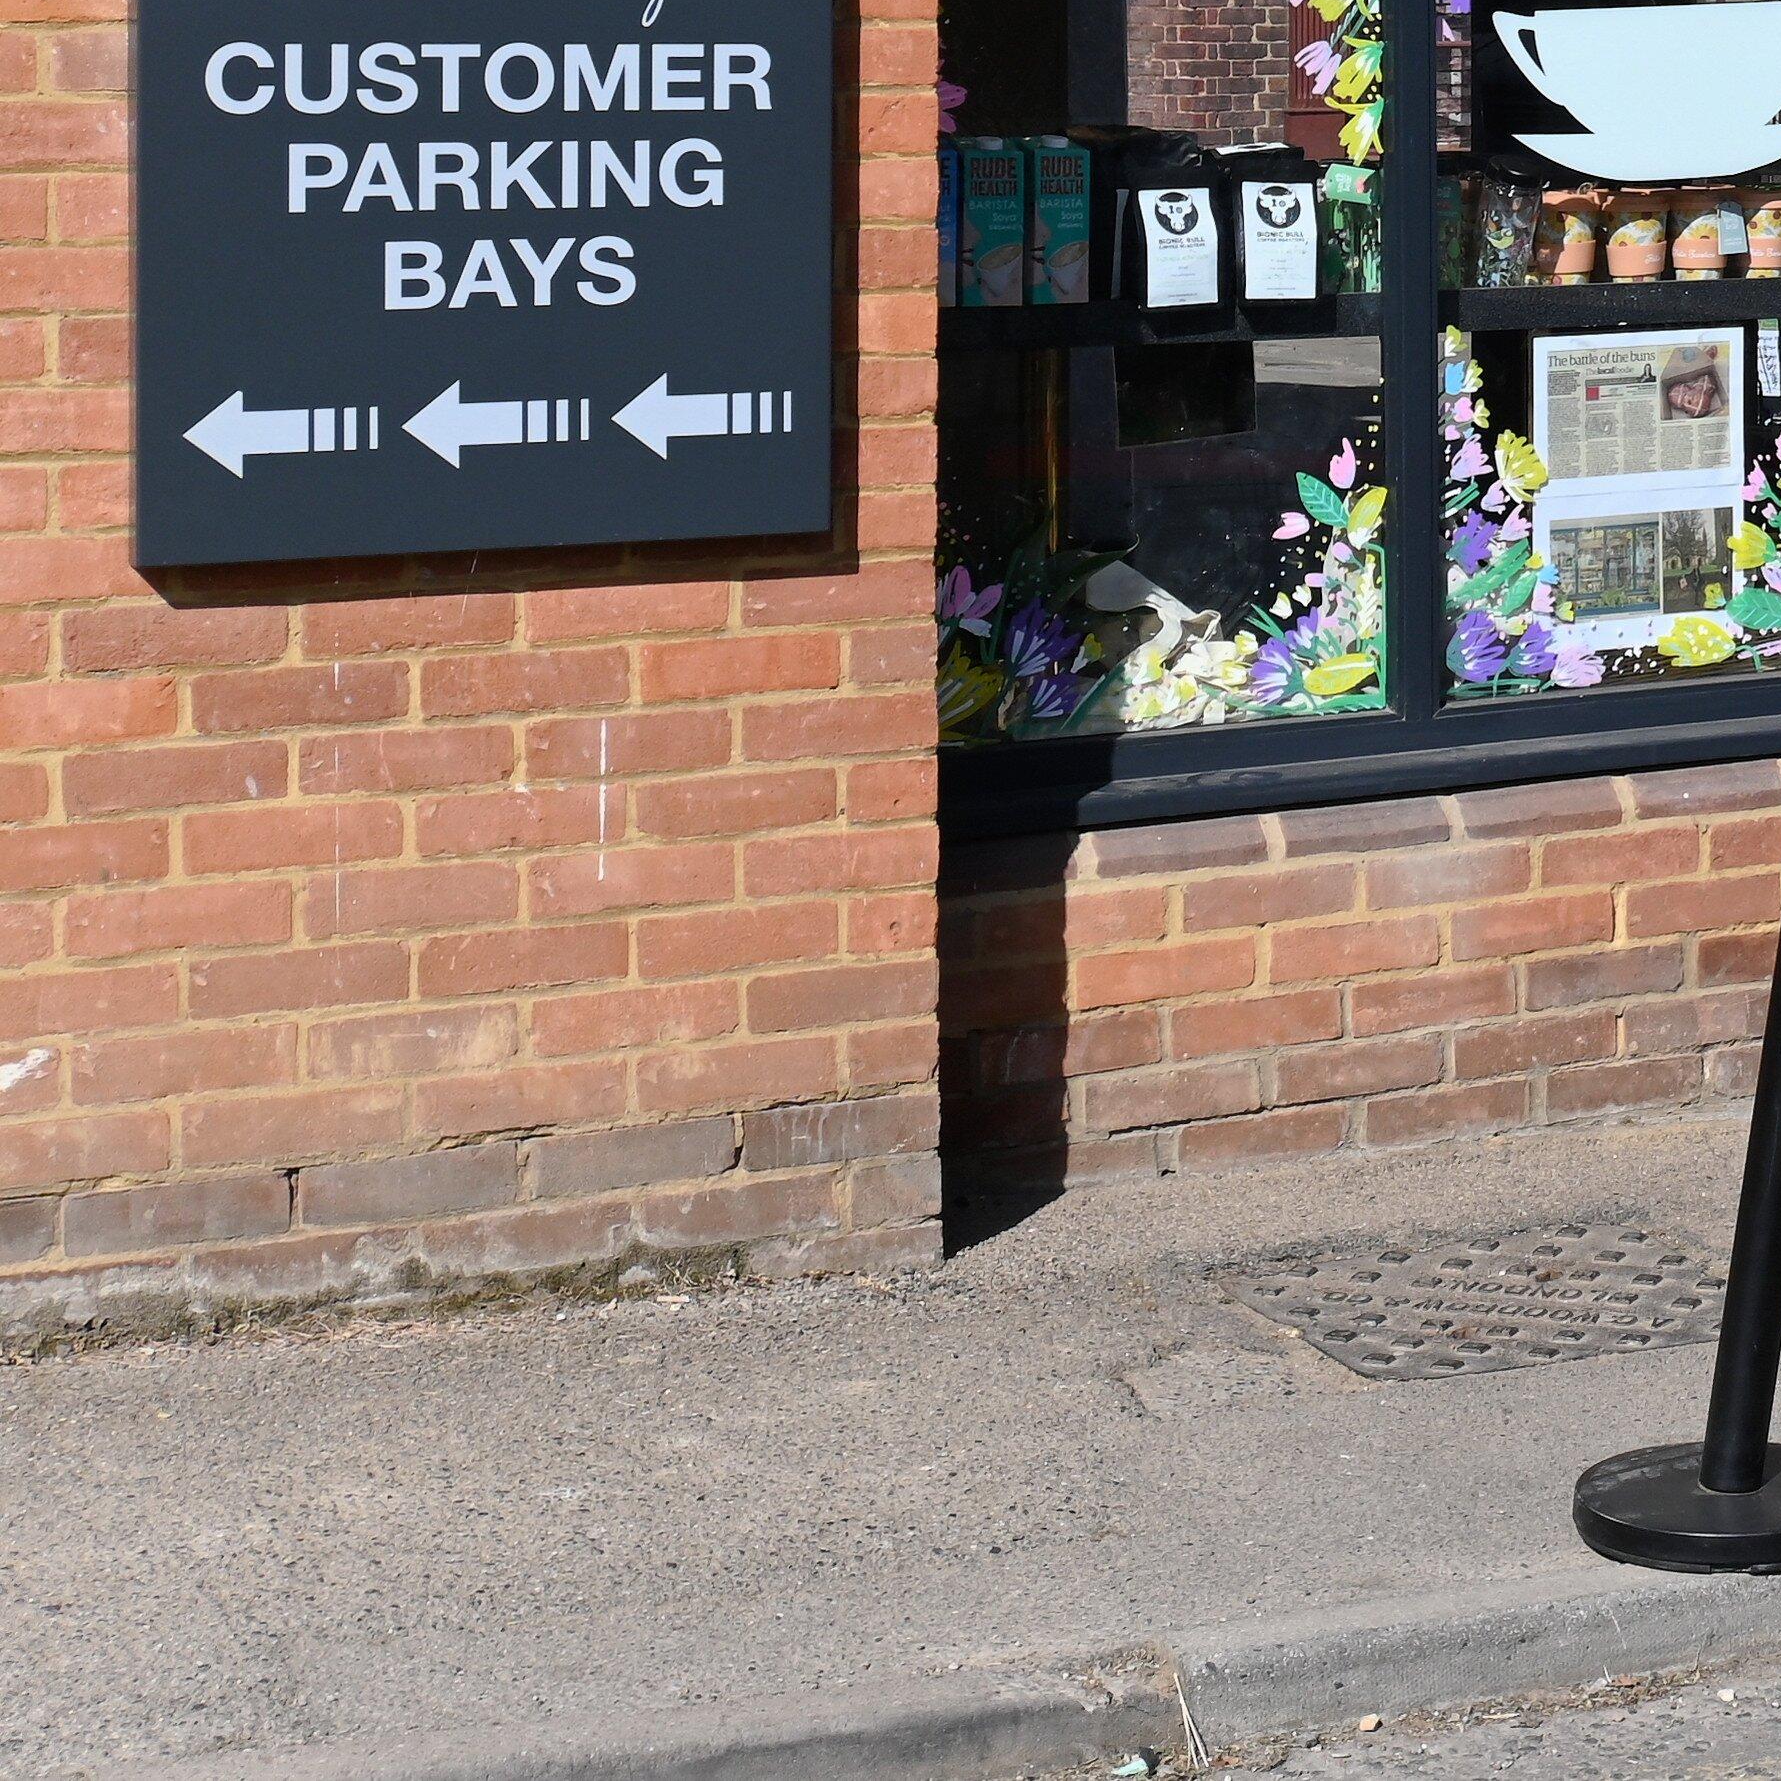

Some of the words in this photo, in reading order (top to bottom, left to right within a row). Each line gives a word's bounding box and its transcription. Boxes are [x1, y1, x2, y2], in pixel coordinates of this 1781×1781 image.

[204, 41, 774, 116] CUSTOMER
[286, 138, 726, 214] PARKING
[970, 157, 1017, 178] RUDE
[1040, 155, 1084, 178] RUDE
[971, 179, 1018, 197] HEALTH
[1040, 178, 1084, 195] HEALTH
[968, 200, 1017, 210] BARISTA
[1039, 197, 1084, 208] BARISTA
[383, 235, 638, 311] BAYS
[1547, 355, 1568, 368] The
[1569, 353, 1598, 367] battle
[1600, 352, 1612, 365] of
[1611, 352, 1630, 364] the
[1630, 350, 1657, 362] buns
[1450, 1278, 1608, 1303] LONDON
